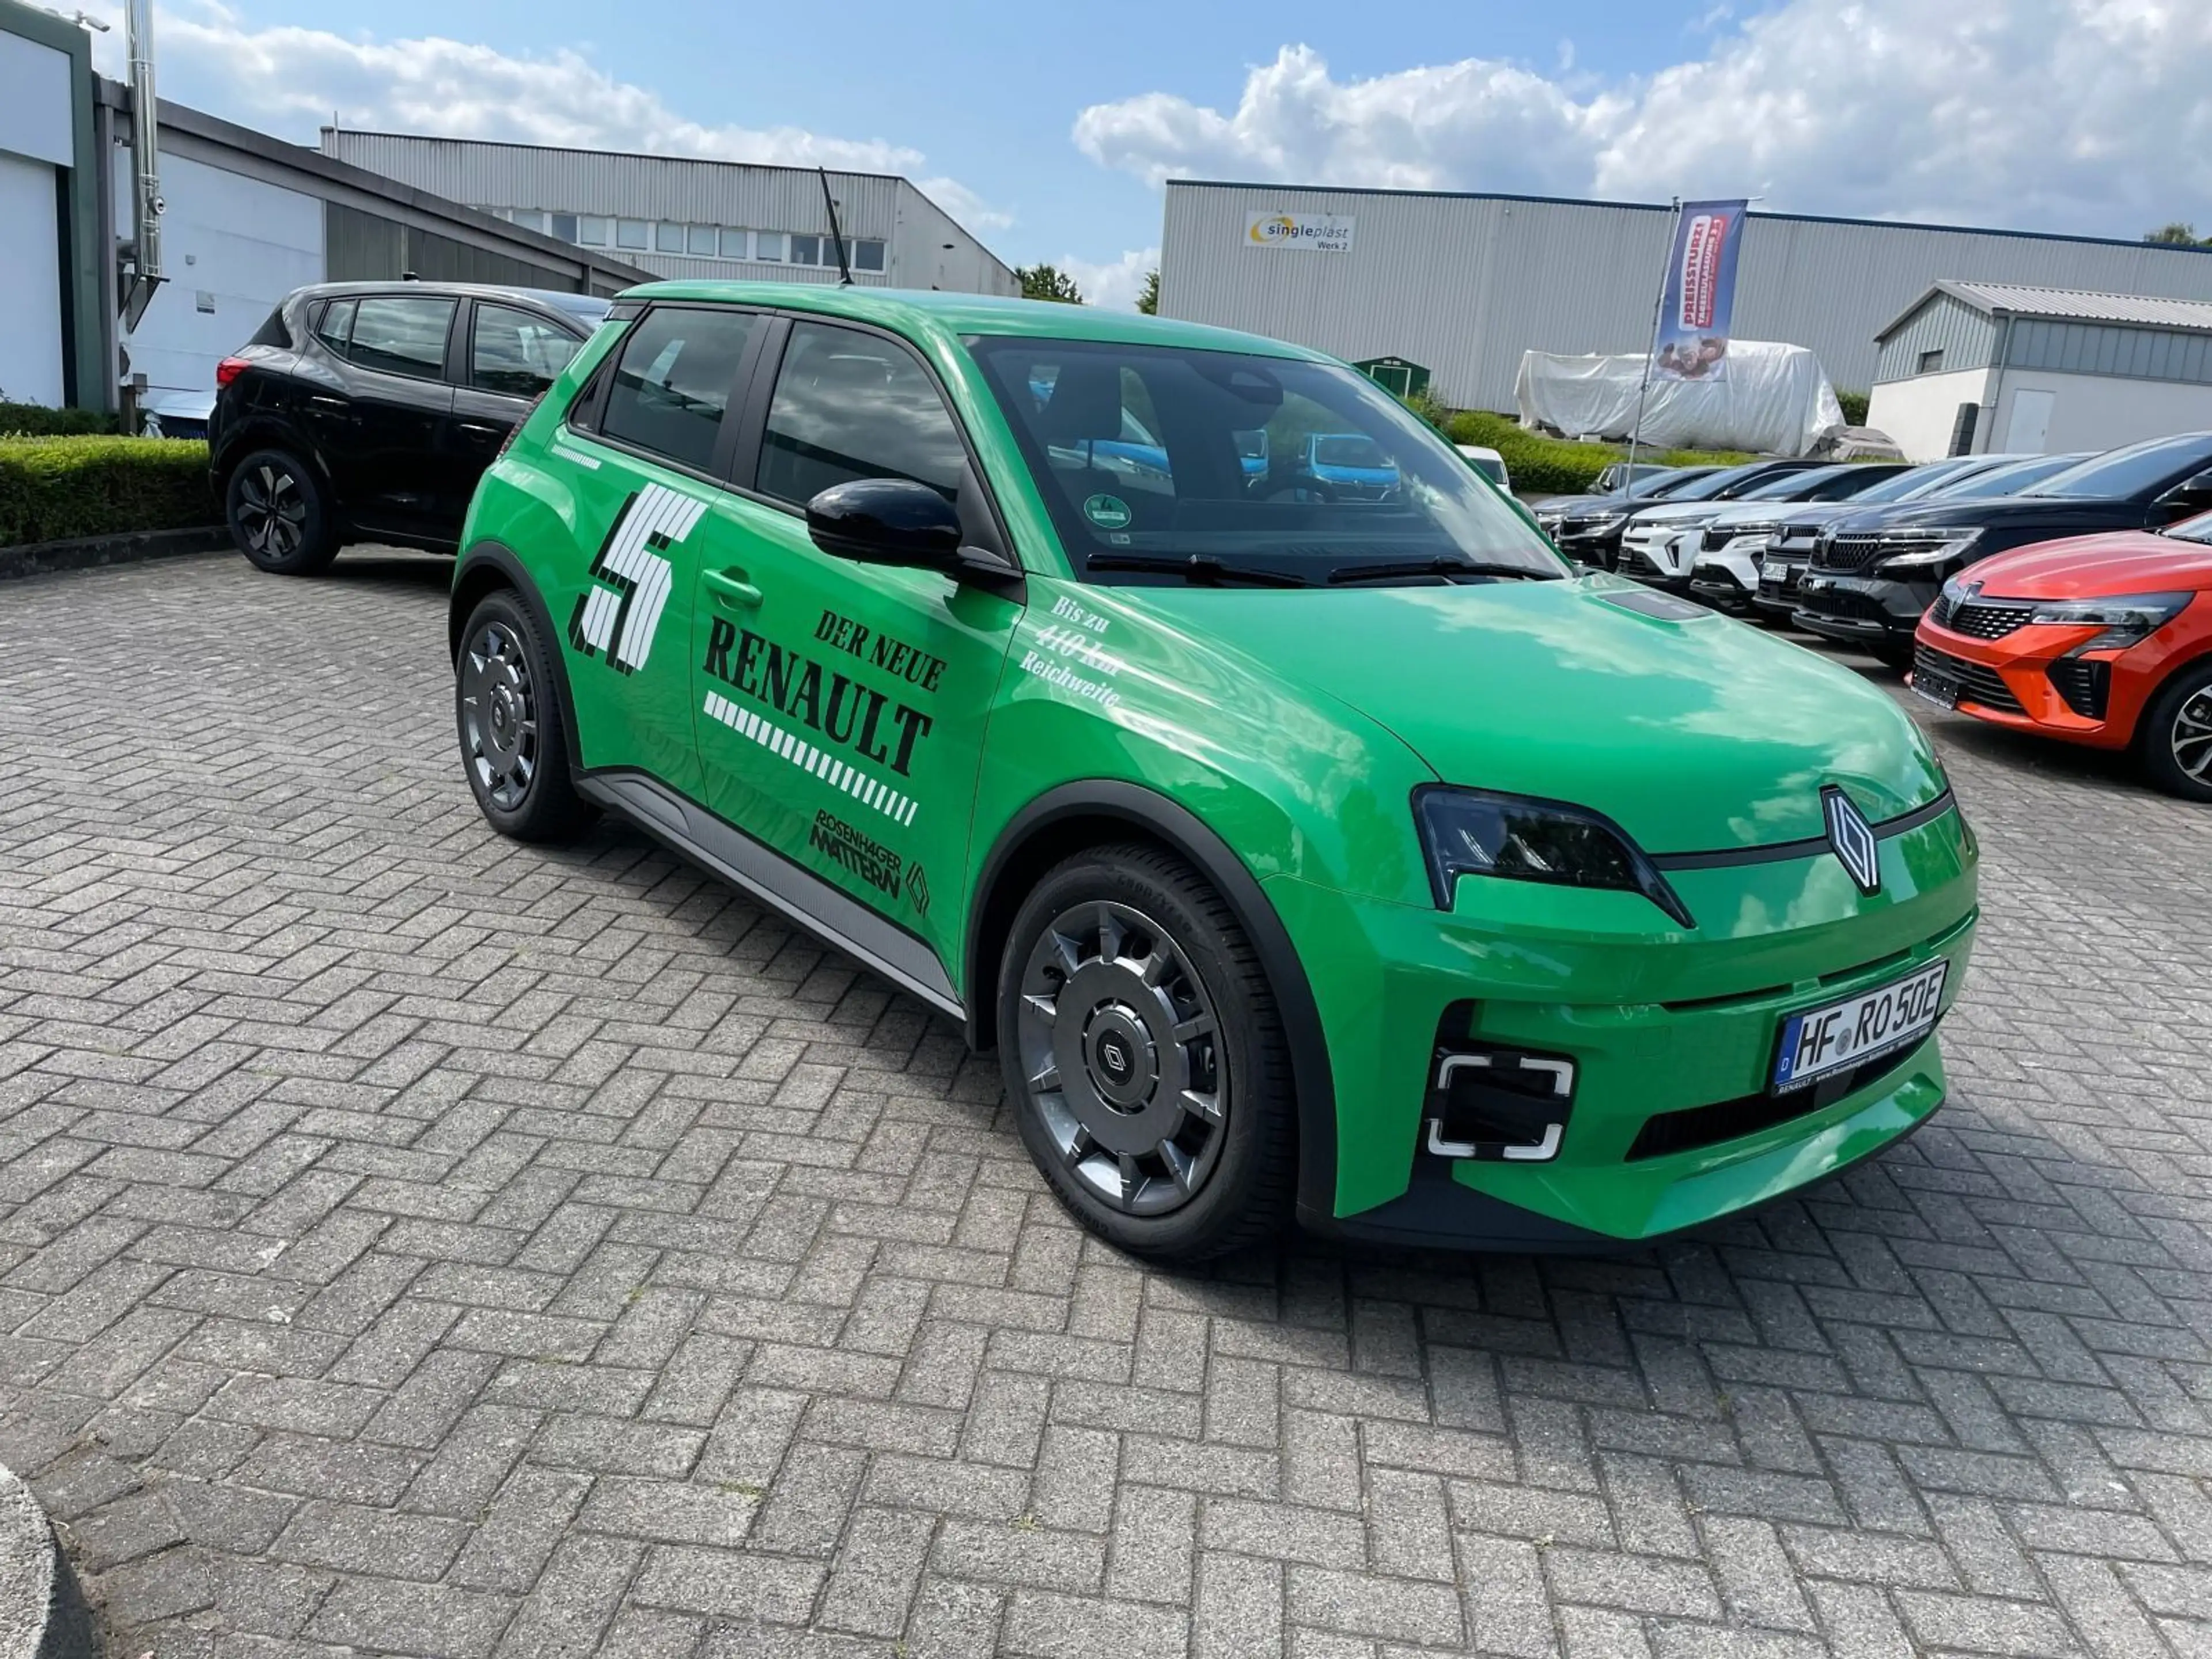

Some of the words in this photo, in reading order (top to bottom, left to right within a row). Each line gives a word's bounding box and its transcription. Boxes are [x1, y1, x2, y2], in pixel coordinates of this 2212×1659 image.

[1267, 224, 1349, 239] singleplast
[1317, 241, 1340, 250] Werk
[567, 482, 709, 678] 5
[1051, 595, 1084, 622] Bis
[1082, 613, 1111, 633] zu
[814, 609, 870, 657] DER
[868, 634, 948, 692] NEUE
[1019, 656, 1121, 707] Reichweite
[703, 615, 934, 778] RENAULT
[809, 823, 900, 900] MATTERN
[815, 808, 902, 874] ROSENHAGER
[1781, 1057, 1790, 1072] D
[1794, 1011, 1842, 1071] HF
[1853, 994, 1892, 1050] RO
